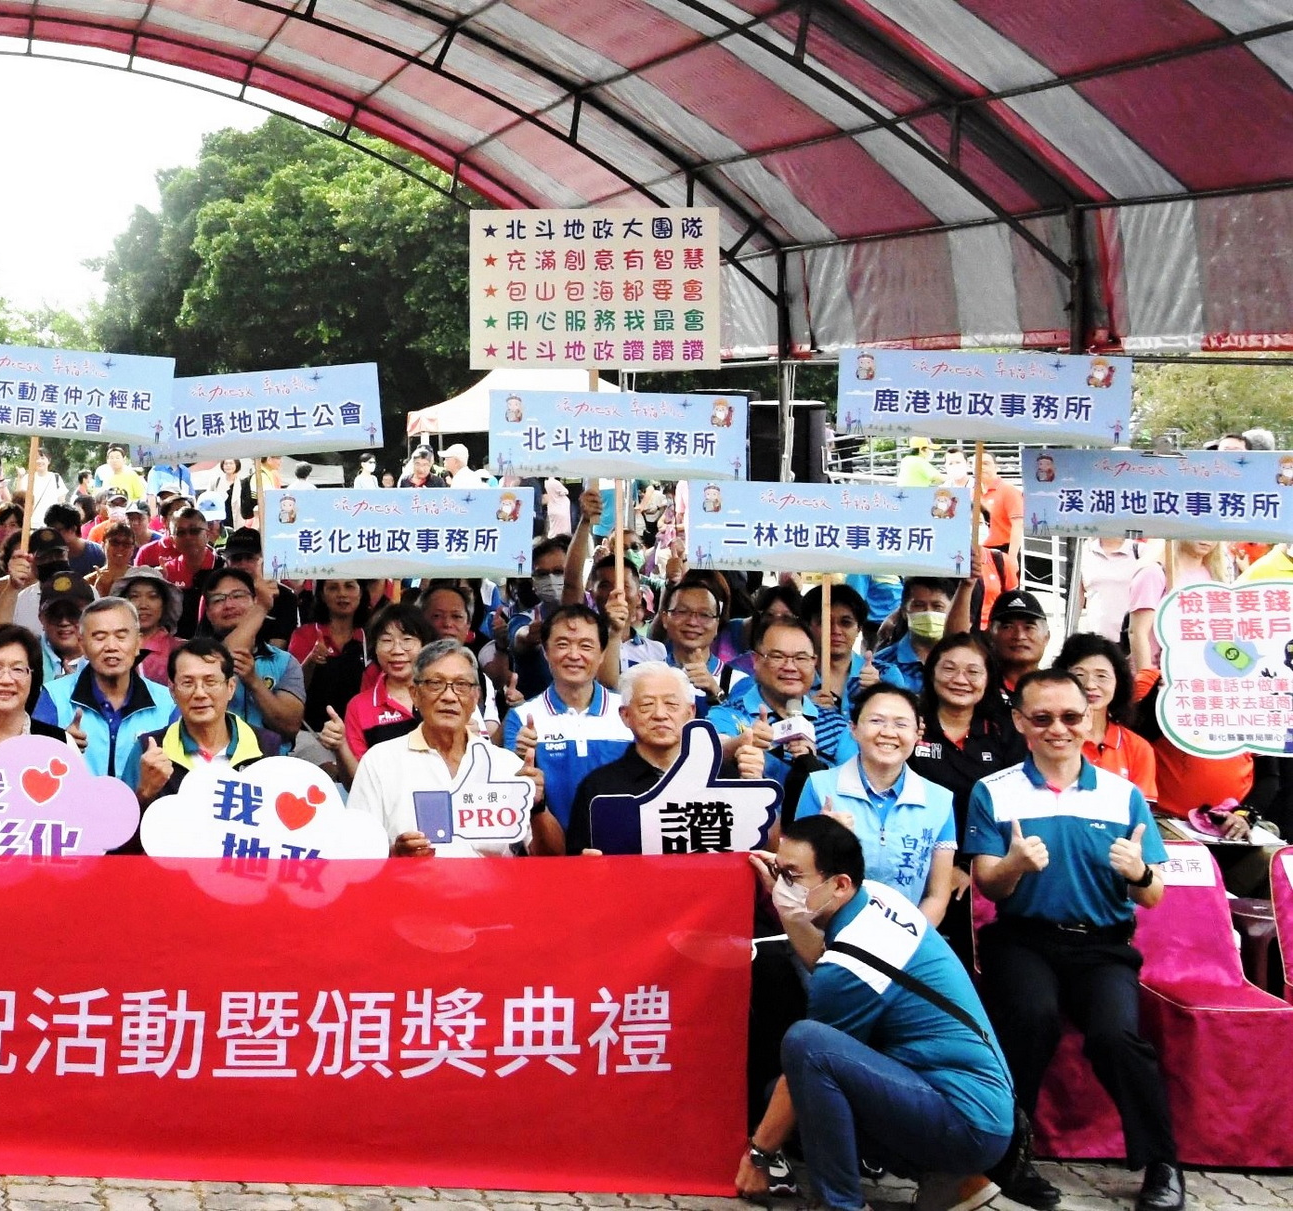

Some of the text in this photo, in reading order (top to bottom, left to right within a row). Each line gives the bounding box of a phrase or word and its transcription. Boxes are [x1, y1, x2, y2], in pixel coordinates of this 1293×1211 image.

[506, 216, 705, 241] 北斗地政大團隊
[506, 247, 706, 273] 充滿創意有智慧
[506, 279, 705, 303] 包山包海都要會
[506, 308, 706, 332] 用心服務我最會
[506, 338, 706, 363] 北斗地政讚讚讚
[872, 386, 1094, 423] 鹿港地政事務所
[521, 425, 718, 459] 北斗地政事務所
[1057, 487, 1282, 520] 溪湖地政事務所
[297, 527, 501, 555] 彰化地政事務所
[722, 521, 936, 555] 二林地政事務所
[1178, 589, 1292, 614] 檢警要錢
[1180, 617, 1292, 641] 監管帳戶
[1174, 678, 1293, 693] 不會電話中做筆
[213, 779, 264, 827] 我
[457, 807, 518, 828] PRO
[659, 801, 734, 855] 讚
[894, 834, 919, 887] 白玉如
[868, 895, 919, 937] FILA
